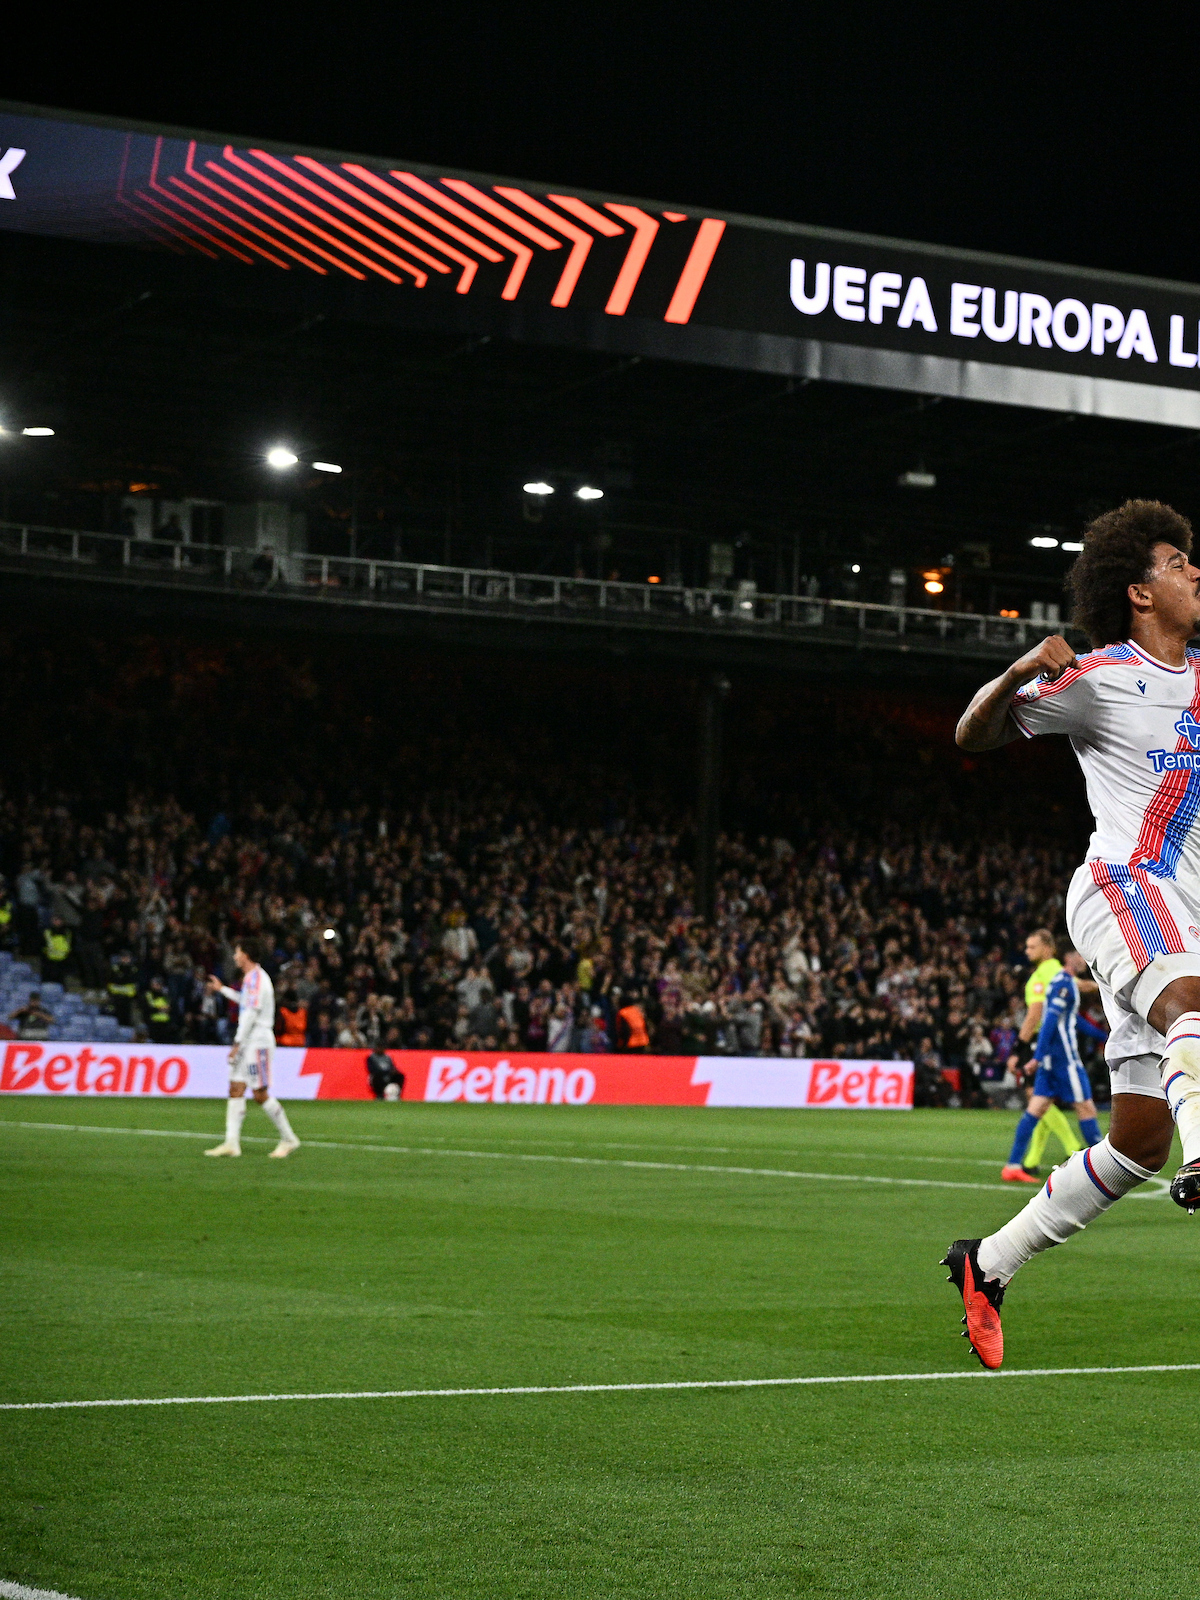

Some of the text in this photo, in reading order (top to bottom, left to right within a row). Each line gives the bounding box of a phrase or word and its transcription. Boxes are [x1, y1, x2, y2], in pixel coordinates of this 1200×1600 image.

[789, 258, 938, 332] UEFA
[950, 282, 1158, 363] EUROPA
[0, 1043, 189, 1094] Betano
[424, 1057, 596, 1105] Betano
